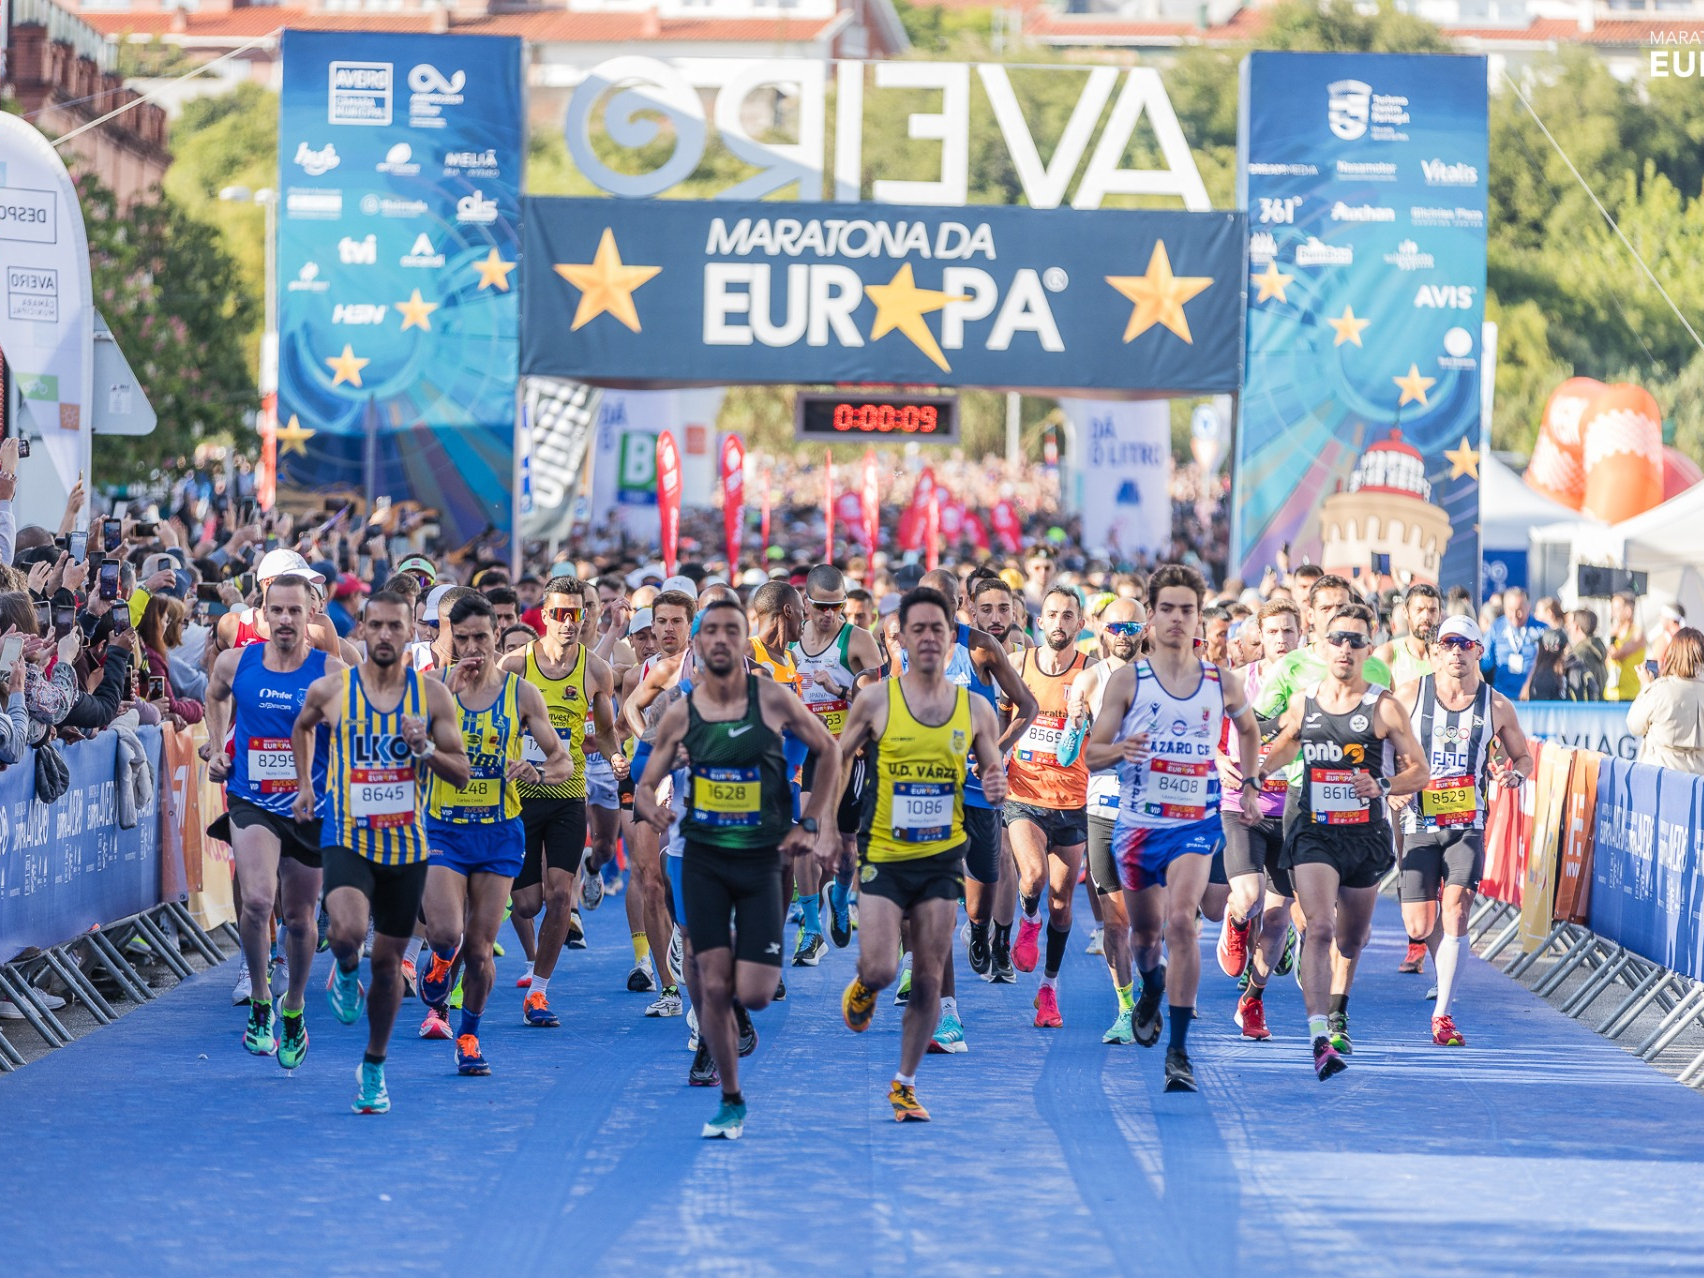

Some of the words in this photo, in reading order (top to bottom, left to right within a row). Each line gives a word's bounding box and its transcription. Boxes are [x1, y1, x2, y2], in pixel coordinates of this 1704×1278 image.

[705, 217, 932, 259] MARATONA
[935, 222, 997, 261] DA
[1413, 284, 1474, 310] AVIS
[833, 403, 938, 433] 0:00:09
[354, 733, 413, 764] LKO
[1150, 738, 1193, 755] ÁZARO
[917, 764, 961, 780] VÁRZE
[362, 785, 405, 802] 8645
[708, 784, 747, 801] 1628
[1158, 776, 1199, 794] 8408
[1432, 790, 1466, 805] 8529
[441, 807, 453, 816] VIP
[906, 799, 943, 815] 1086
[1317, 814, 1327, 822] VIP
